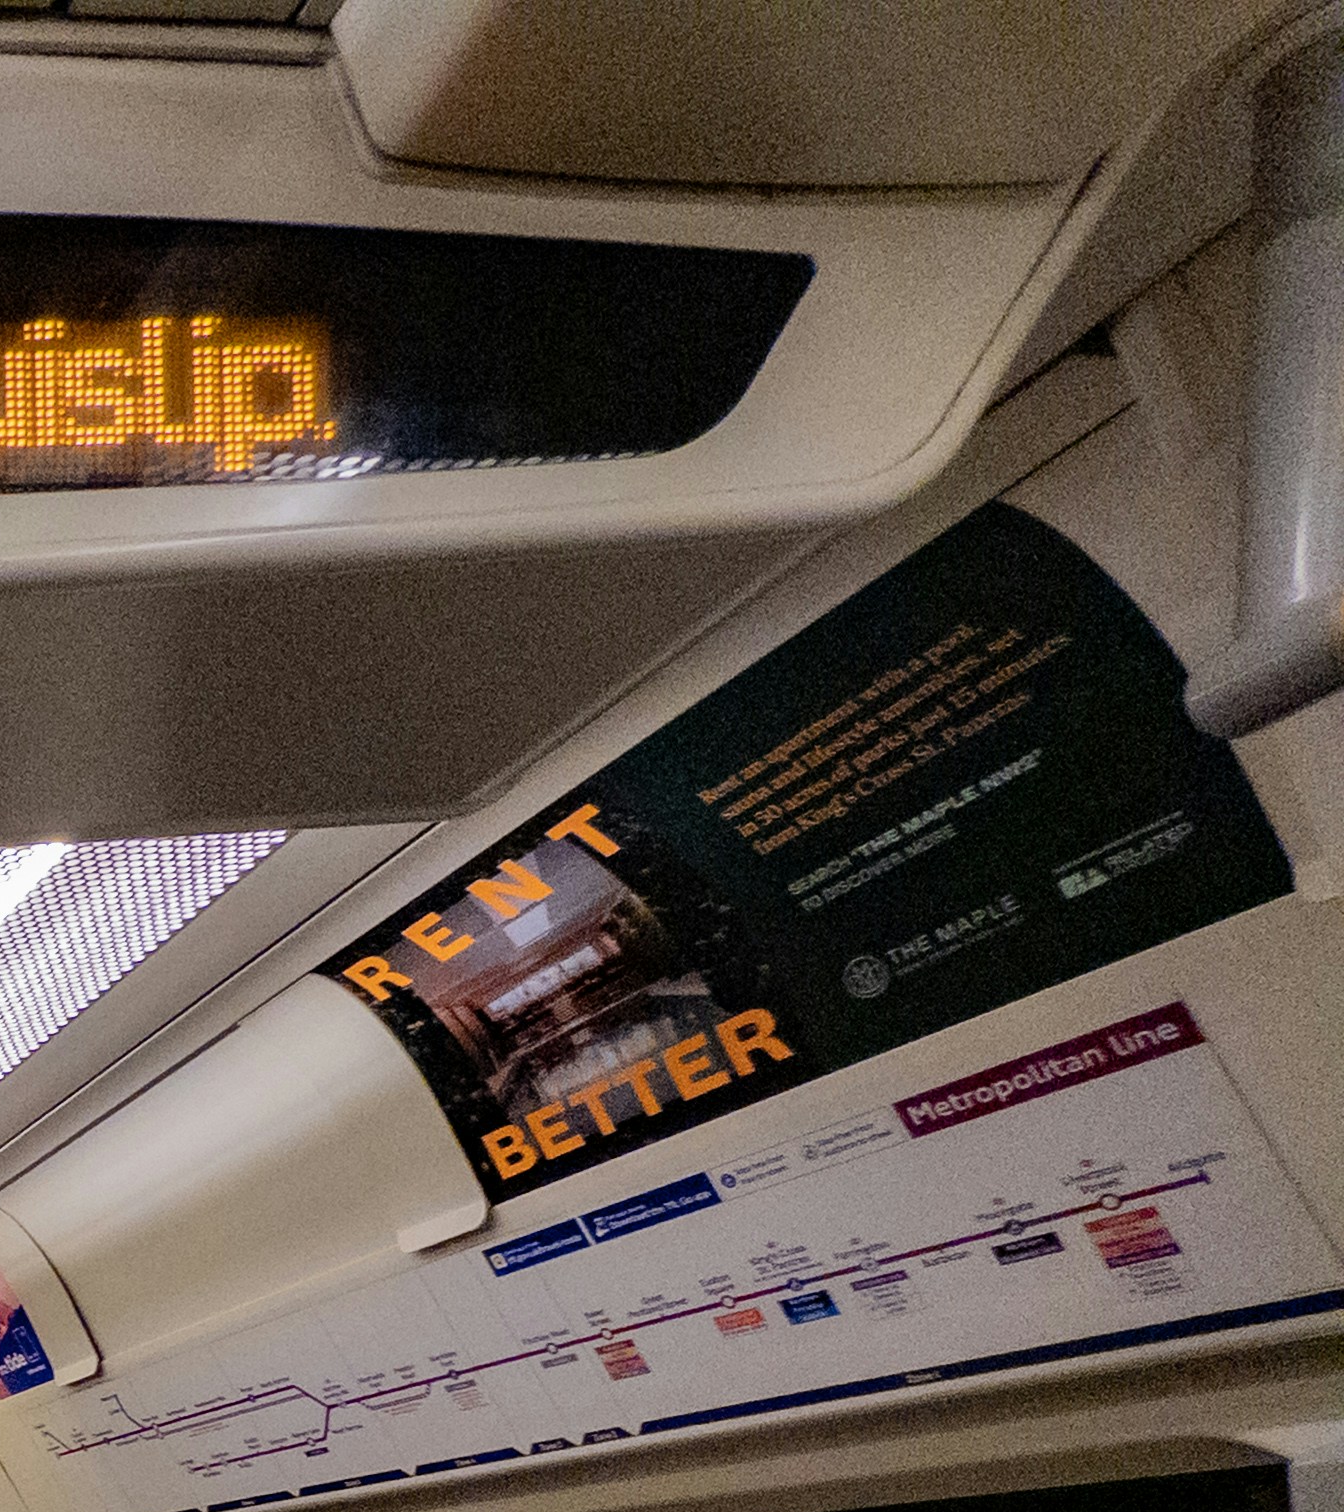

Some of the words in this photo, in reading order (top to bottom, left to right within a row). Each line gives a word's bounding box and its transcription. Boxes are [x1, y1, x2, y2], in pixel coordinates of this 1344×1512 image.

[739, 760, 768, 781] an
[762, 699, 863, 764] apartment
[860, 668, 910, 700] with
[769, 760, 808, 791] and
[787, 855, 853, 897] SEARCH
[899, 783, 981, 835] MAPLE
[799, 894, 825, 913] TO
[820, 850, 907, 903] DISCOVER
[903, 822, 960, 860] MORE
[343, 803, 626, 1001] RENT
[886, 932, 933, 965] THE
[934, 893, 1022, 944] MAPLE
[481, 1006, 794, 1181] BETTER
[906, 1049, 1109, 1125] Metropolitan
[1106, 1021, 1181, 1057] line
